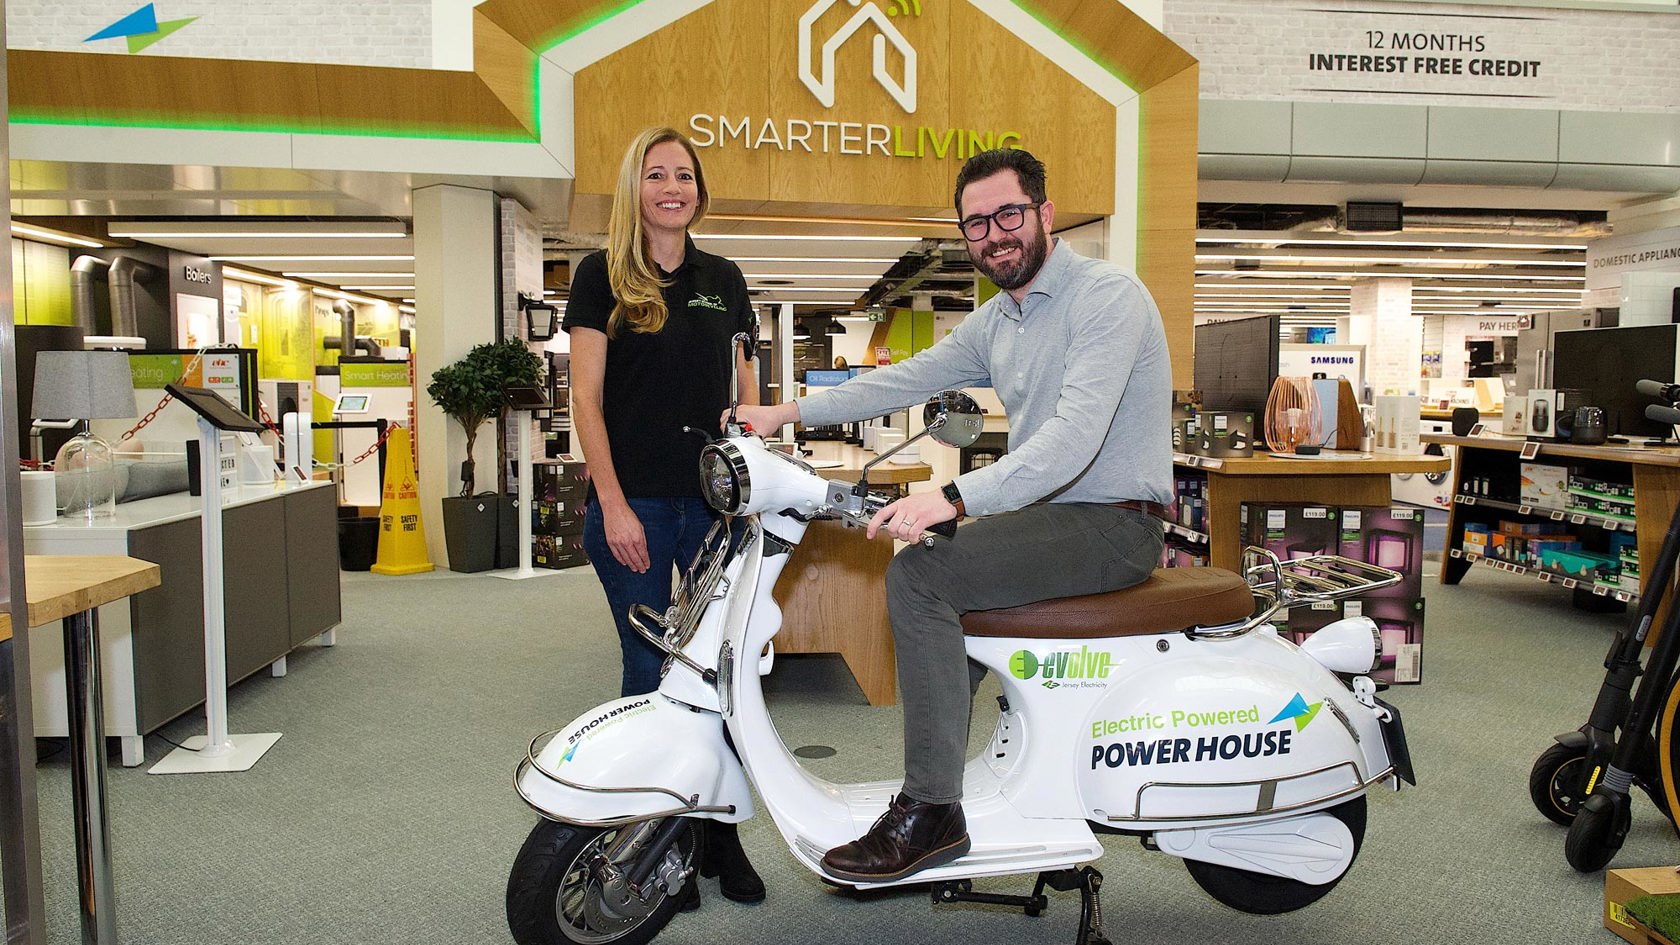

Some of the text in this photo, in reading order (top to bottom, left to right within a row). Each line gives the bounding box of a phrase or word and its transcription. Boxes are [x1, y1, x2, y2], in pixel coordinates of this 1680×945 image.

[1366, 31, 1485, 52] 12 MONTHS
[1309, 53, 1541, 77] INTEREST FREE CREDIT
[1593, 253, 1637, 269] DOMESTIC
[184, 265, 212, 284] Boilers
[1480, 321, 1518, 331] PAY HER
[1311, 356, 1354, 364] SAMSUNG
[130, 366, 164, 381] eating
[345, 370, 409, 381] Smart Heatin
[401, 514, 417, 523] SAFETY
[403, 523, 417, 531] FIRST
[1042, 645, 1111, 679] evolve
[1062, 681, 1108, 690] Jersey Electricity
[567, 699, 651, 745] POWER HOUSE
[1092, 704, 1260, 739] Electric Powered
[1091, 729, 1292, 770] POWER HOUSE
